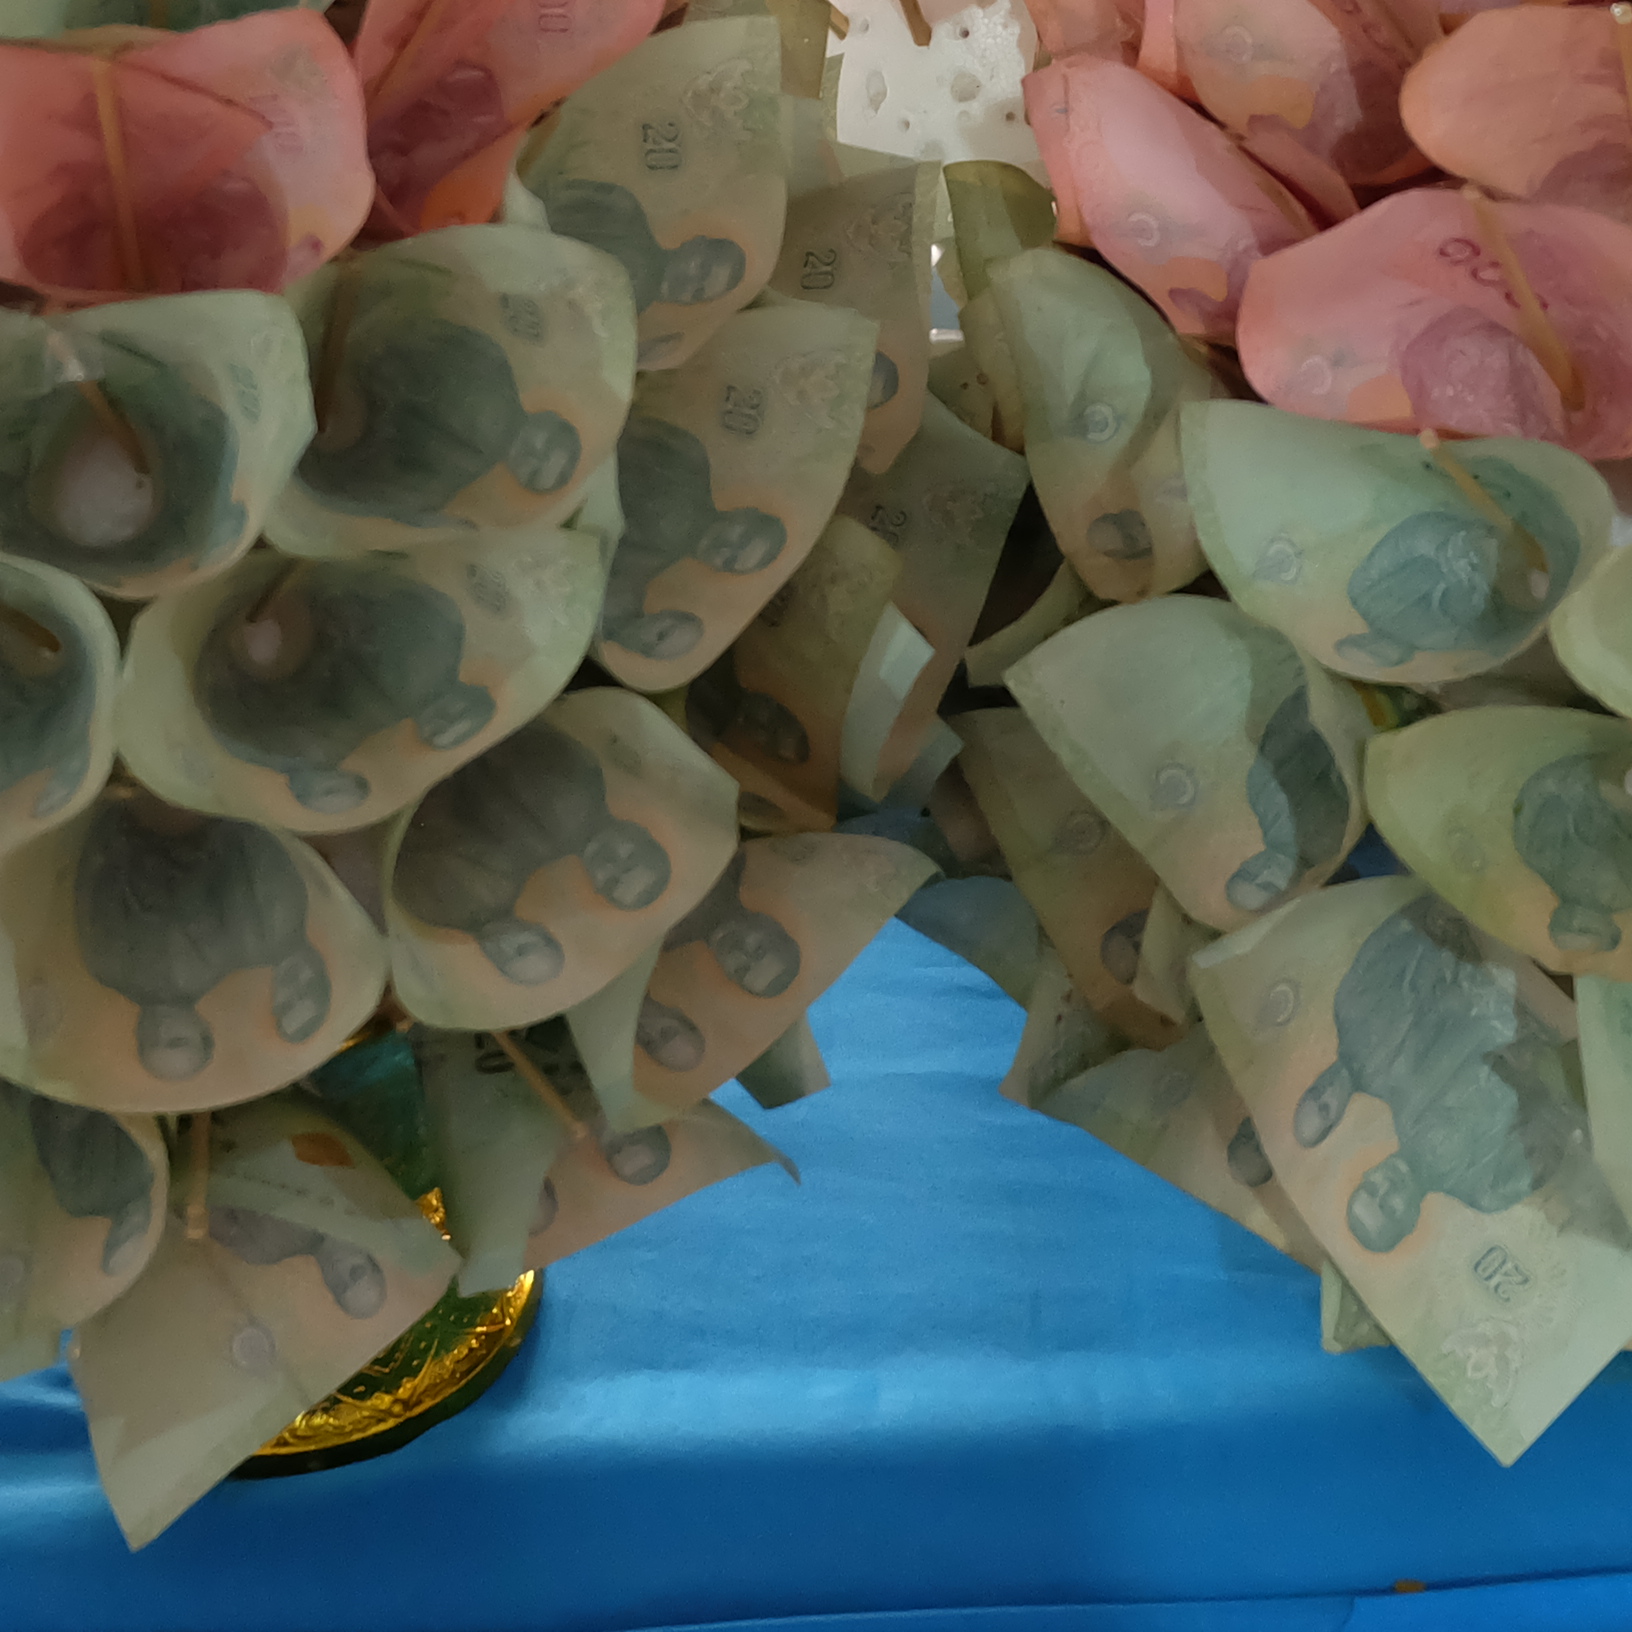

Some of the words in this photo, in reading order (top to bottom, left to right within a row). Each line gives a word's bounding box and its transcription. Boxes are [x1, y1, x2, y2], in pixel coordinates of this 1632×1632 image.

[642, 121, 684, 174] 20
[801, 246, 837, 293] 20
[721, 385, 763, 436] 20
[1471, 1244, 1537, 1304] 20
